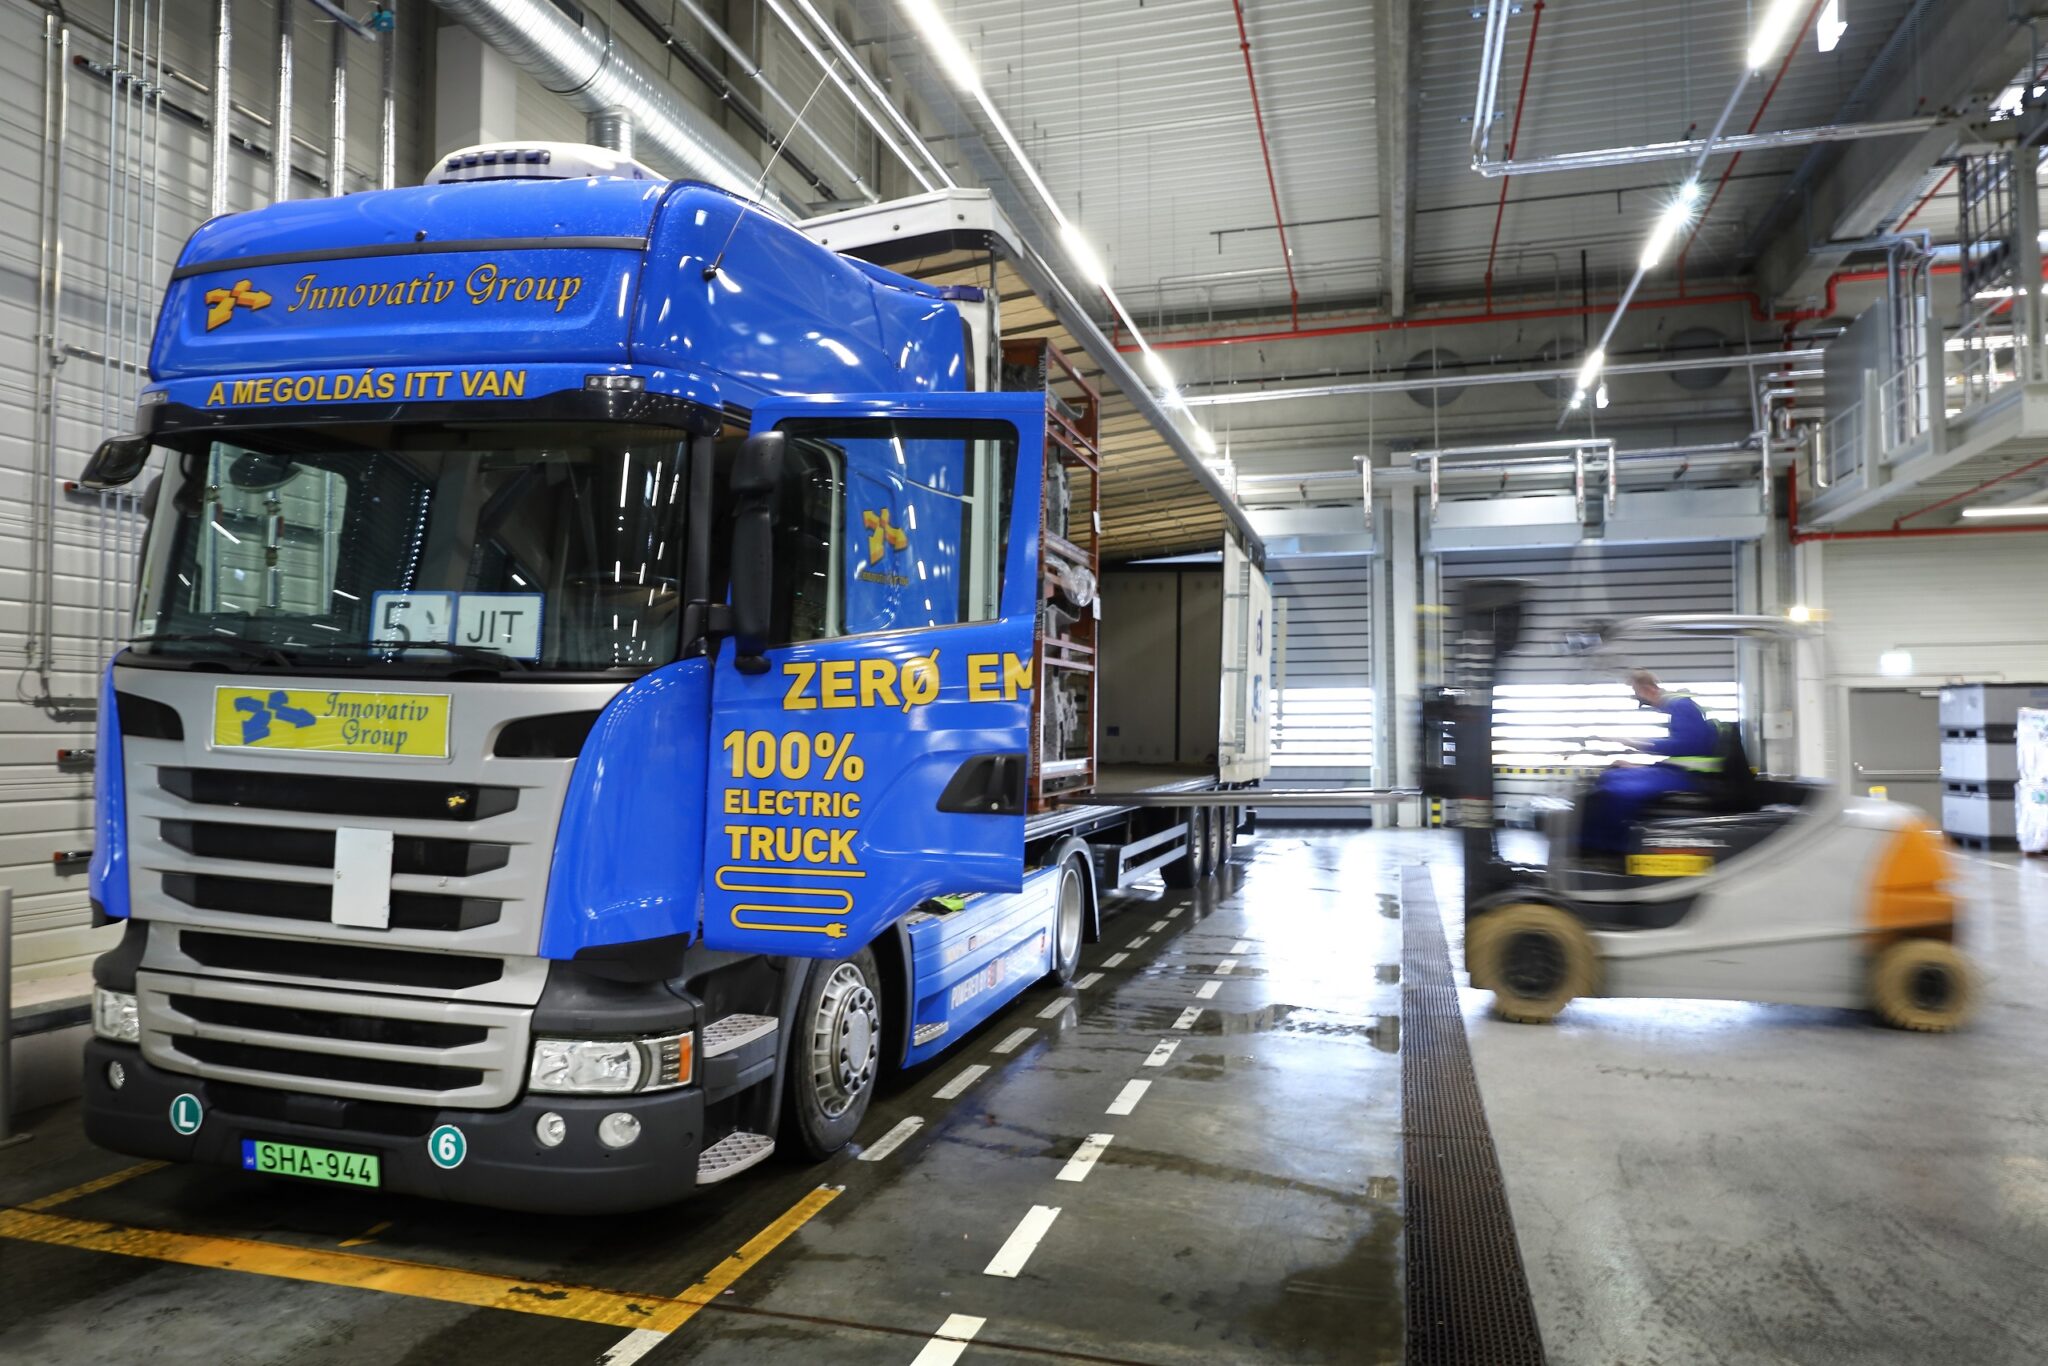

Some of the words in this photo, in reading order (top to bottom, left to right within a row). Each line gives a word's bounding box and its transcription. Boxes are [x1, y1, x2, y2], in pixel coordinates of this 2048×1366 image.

[287, 272, 456, 313] Innovativ
[465, 263, 582, 313] Group
[206, 383, 225, 406] A
[232, 368, 395, 404] MEGOLDÁS
[403, 371, 452, 399] ITT
[460, 370, 527, 398] VAN
[467, 610, 524, 644] JIT
[324, 692, 429, 721] Innovativ
[342, 718, 408, 753] Group
[723, 730, 865, 782] 100%
[724, 788, 861, 818] ELECTRIC
[724, 825, 858, 864] TRUCK
[178, 1101, 195, 1128] L
[261, 1144, 372, 1183] SHA-944
[438, 1133, 457, 1160] 6
